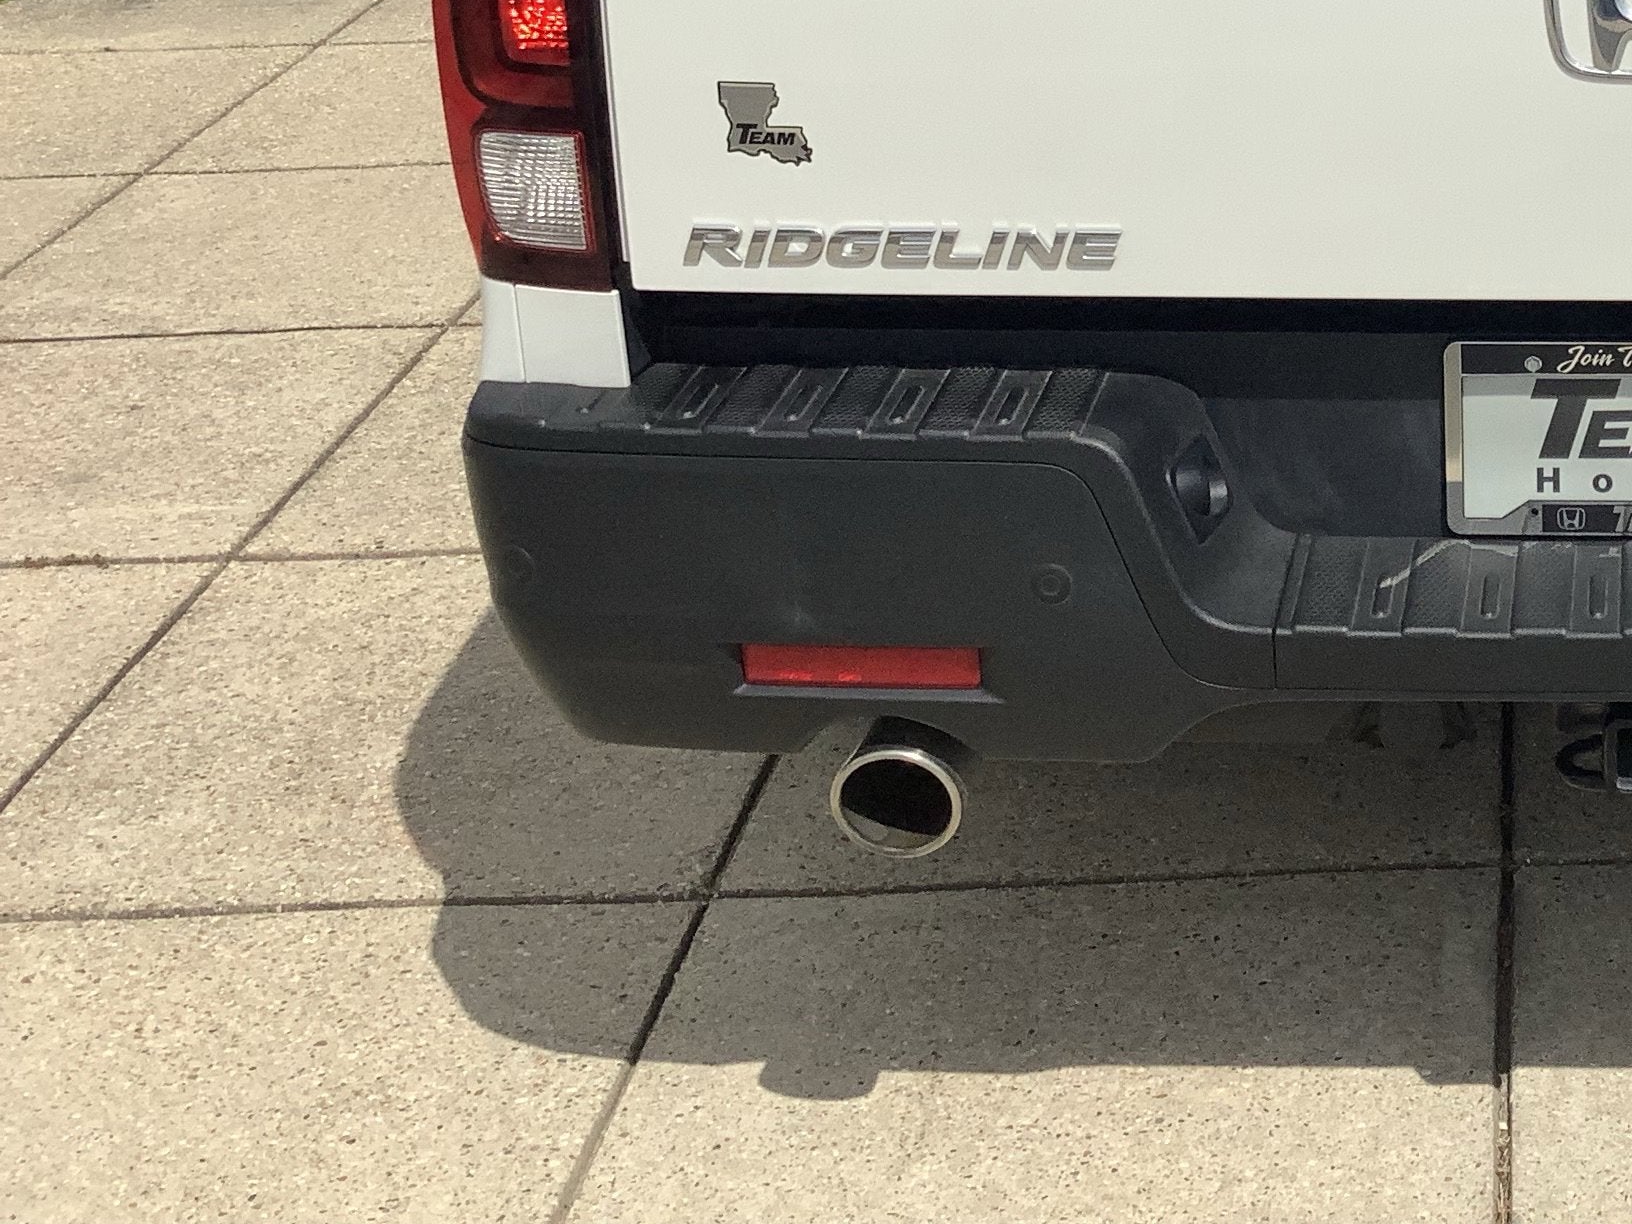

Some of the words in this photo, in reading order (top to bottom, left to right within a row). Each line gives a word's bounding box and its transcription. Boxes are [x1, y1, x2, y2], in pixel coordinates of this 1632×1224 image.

[736, 123, 796, 145] TEAM
[683, 223, 1122, 271] RIDGELINE
[1557, 345, 1615, 373] Join
